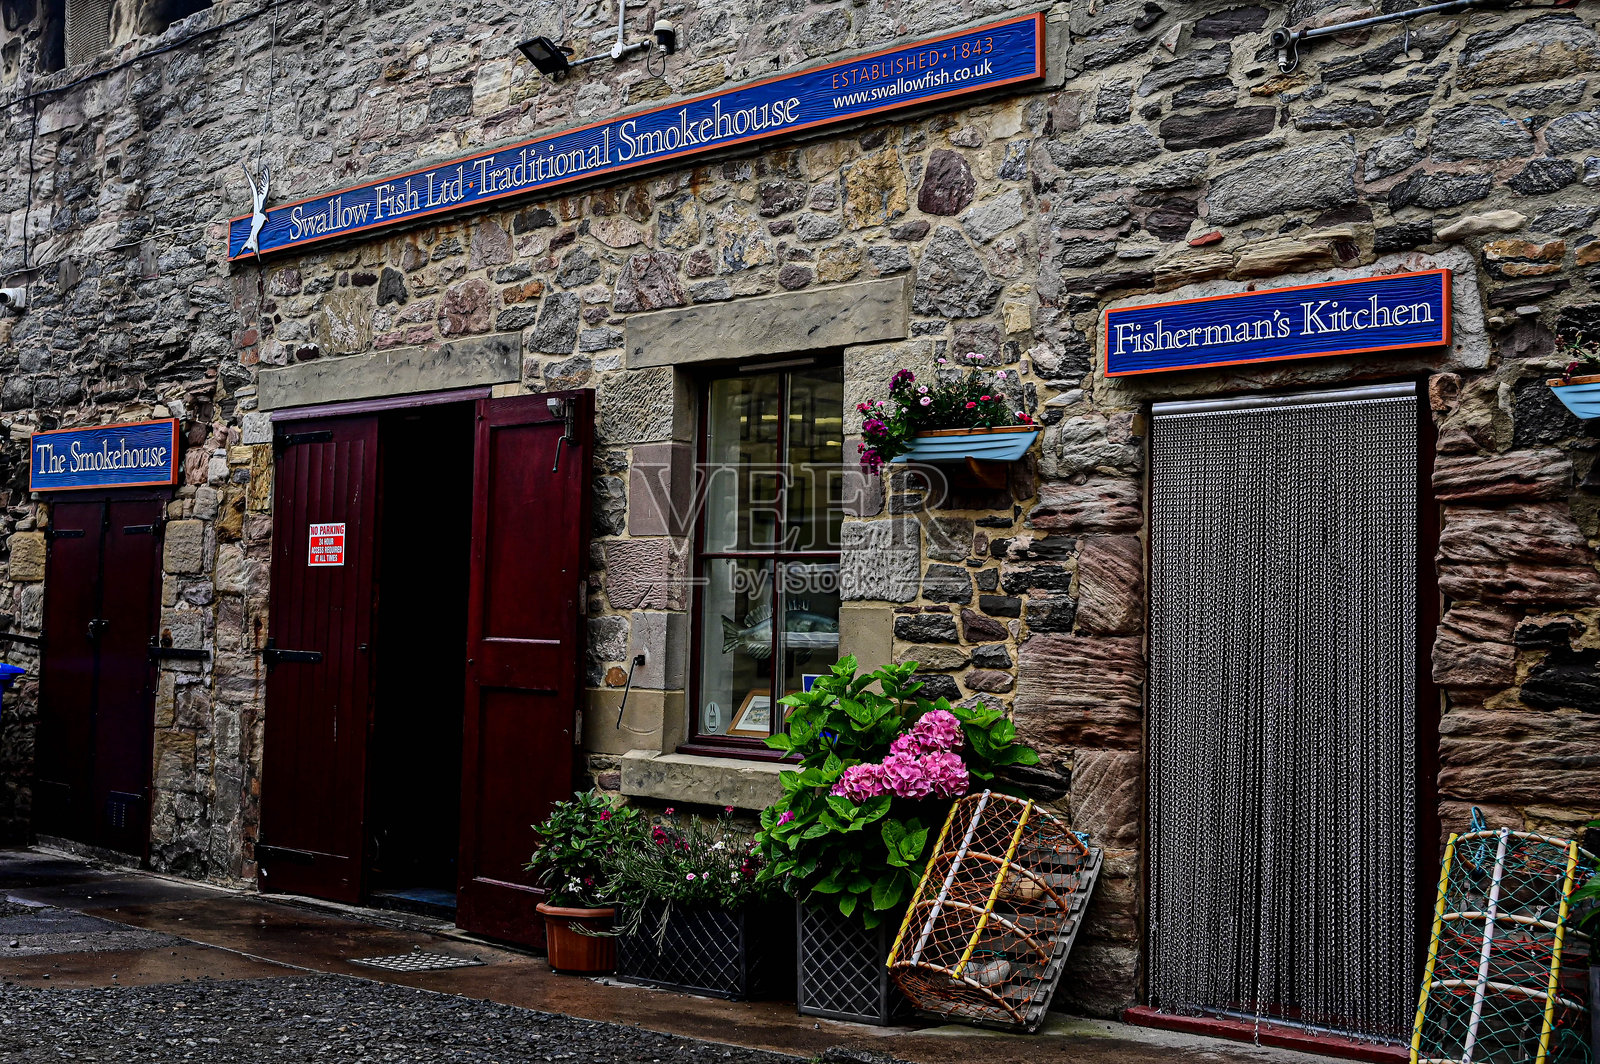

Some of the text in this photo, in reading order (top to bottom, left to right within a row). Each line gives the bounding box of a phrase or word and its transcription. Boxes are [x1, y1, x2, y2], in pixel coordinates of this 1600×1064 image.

[832, 36, 994, 90] ESTABLISHED 1843
[832, 58, 993, 109] www.swallowfish.co.uk
[289, 96, 801, 240] Swallow Fish Ltd Traditional Smokehouse
[1113, 294, 1435, 355] Fisherman's Kitchen
[36, 438, 167, 474] The Smokehouse
[311, 525, 345, 536] NO PARKING
[324, 537, 334, 545] HOUR
[311, 545, 342, 554] ACCESS REQUIRED
[326, 554, 338, 562] TIMES
